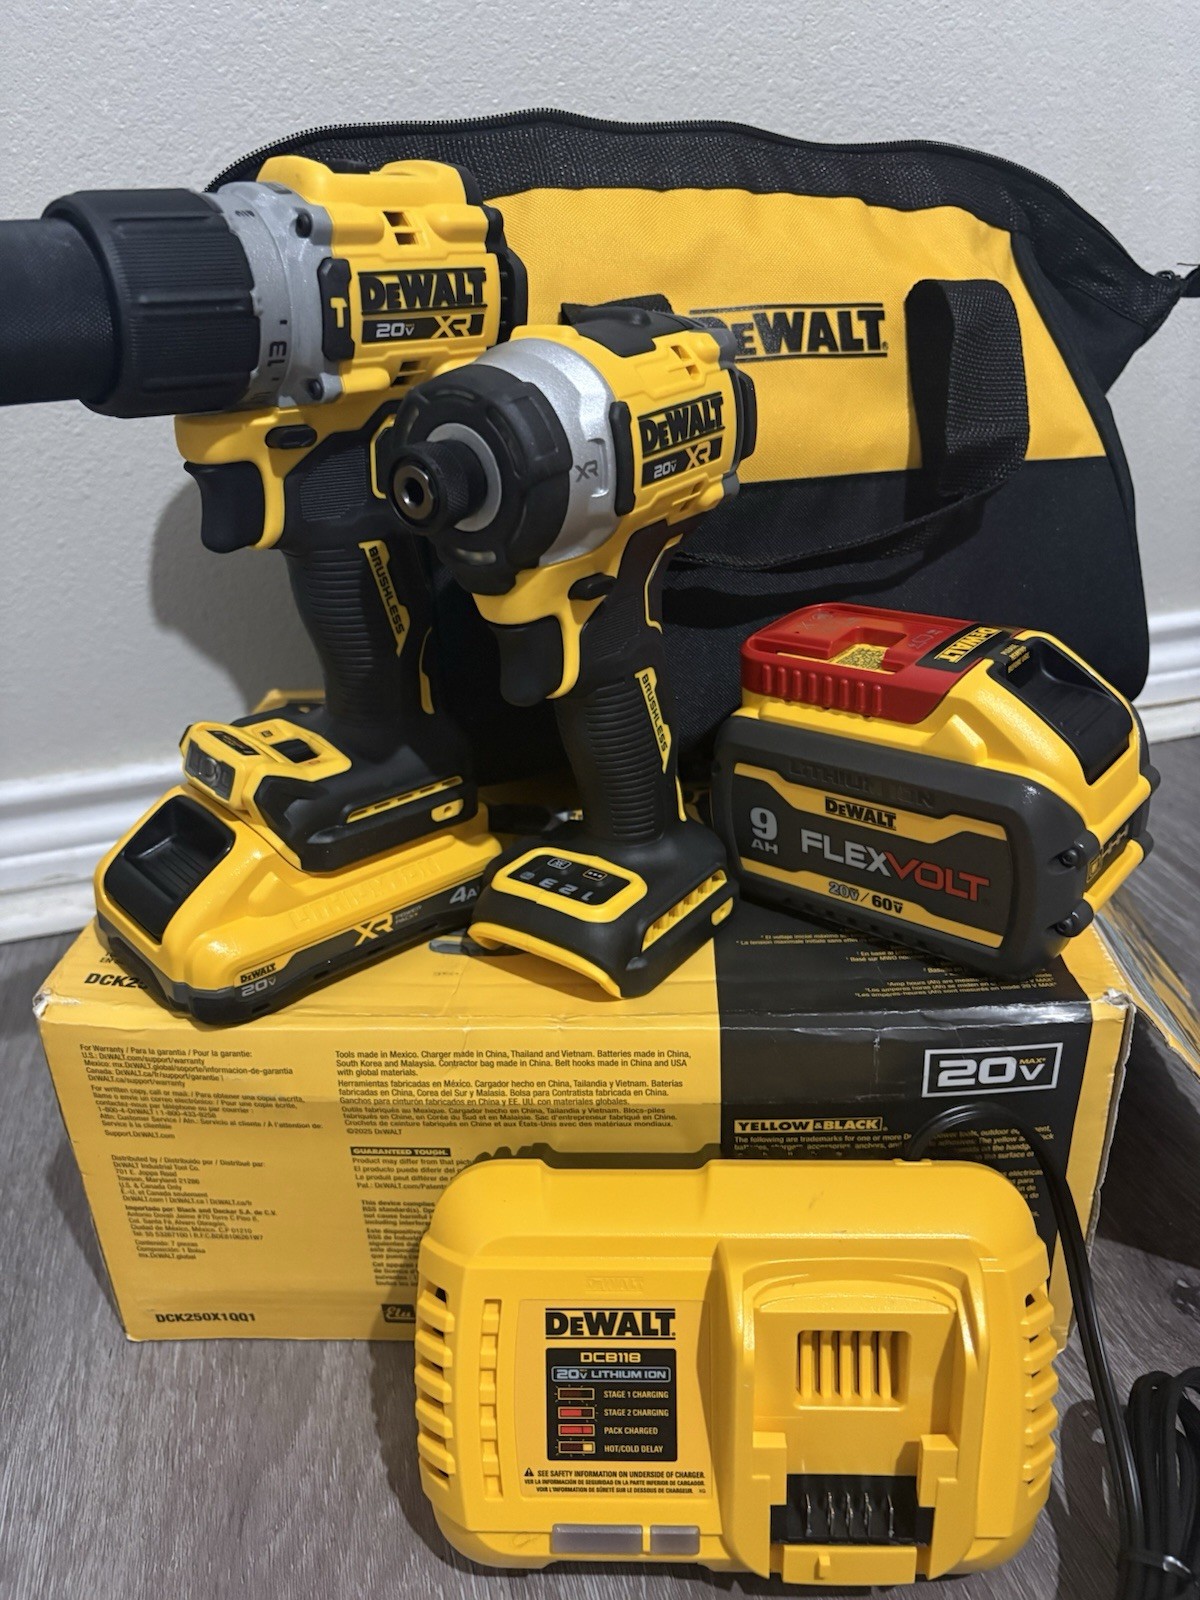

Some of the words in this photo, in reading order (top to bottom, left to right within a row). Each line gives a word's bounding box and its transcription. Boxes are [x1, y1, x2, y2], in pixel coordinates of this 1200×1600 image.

[359, 270, 486, 311] DEWALT
[431, 314, 472, 339] XR
[267, 341, 288, 367] 13
[638, 396, 724, 455] DEWALT
[686, 440, 711, 471] XR
[575, 460, 599, 482] XR
[369, 546, 405, 634] BRUSHLESS
[935, 627, 1002, 663] DEWALT
[642, 674, 668, 752] BRUSHLESS
[825, 797, 897, 828] DEWALT
[750, 807, 777, 840] 9
[751, 839, 778, 855] AH
[801, 828, 990, 901] FLEXVOLT
[355, 912, 394, 946] XR
[240, 963, 276, 983] DEWALT
[400, 1060, 436, 1068] Malaysia.
[479, 1060, 494, 1068] bag
[420, 1051, 451, 1059] Charger
[485, 1050, 509, 1059] China,
[666, 1051, 691, 1059] China,
[355, 1069, 378, 1077] global
[391, 1089, 414, 1097] China,
[474, 1080, 508, 1088] Cargador
[547, 1080, 571, 1088] China,
[749, 1135, 784, 1144] following
[155, 1313, 256, 1323] DCK250X1QQ1
[545, 1312, 676, 1336] DEWALT
[580, 1352, 641, 1363] DCB118
[591, 1370, 642, 1379] LITHIUM
[644, 1371, 667, 1379] ION
[604, 1391, 625, 1399] STAGE
[627, 1391, 631, 1399] 1
[632, 1391, 669, 1399] CHARGING
[604, 1409, 625, 1417] STAGE
[627, 1409, 631, 1417] 2
[633, 1409, 669, 1417] CHARGING
[604, 1445, 639, 1453] HOT/COLD
[641, 1445, 663, 1453] DELAY
[538, 1470, 548, 1478] SEE
[549, 1470, 572, 1478] SAFETY
[573, 1470, 617, 1478] INFORMATION
[618, 1470, 628, 1478] ON
[628, 1470, 664, 1478] UNDERSIDE
